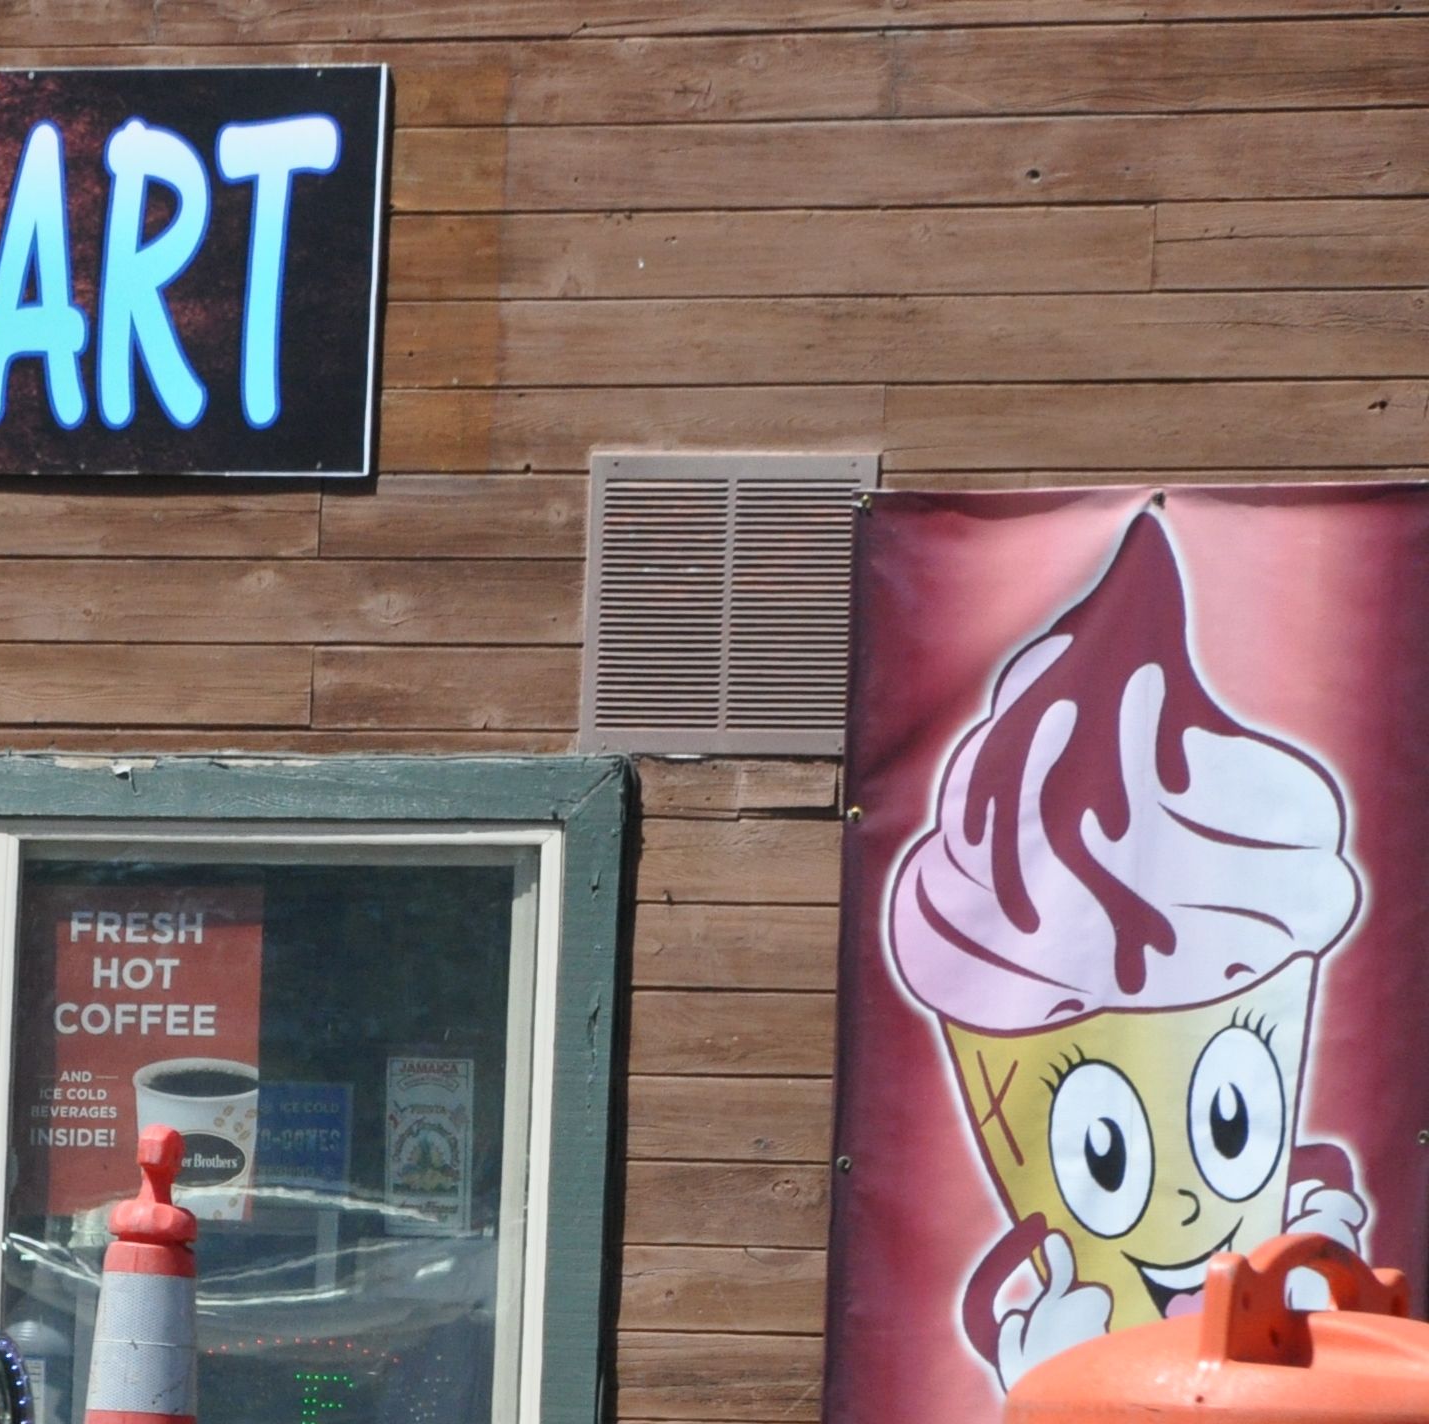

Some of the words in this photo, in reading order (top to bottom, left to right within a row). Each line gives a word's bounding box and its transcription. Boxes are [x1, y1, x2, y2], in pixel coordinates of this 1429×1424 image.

[70, 911, 204, 944] FRESH
[93, 957, 181, 990] HOT
[54, 1002, 218, 1036] COFFEE
[60, 1071, 92, 1082] AND
[39, 1088, 62, 1100] ICE
[66, 1088, 107, 1100] COLD
[30, 1105, 118, 1119] BEVERAGES
[29, 1128, 116, 1147] INSIDE!
[193, 1153, 239, 1169] Brothers
